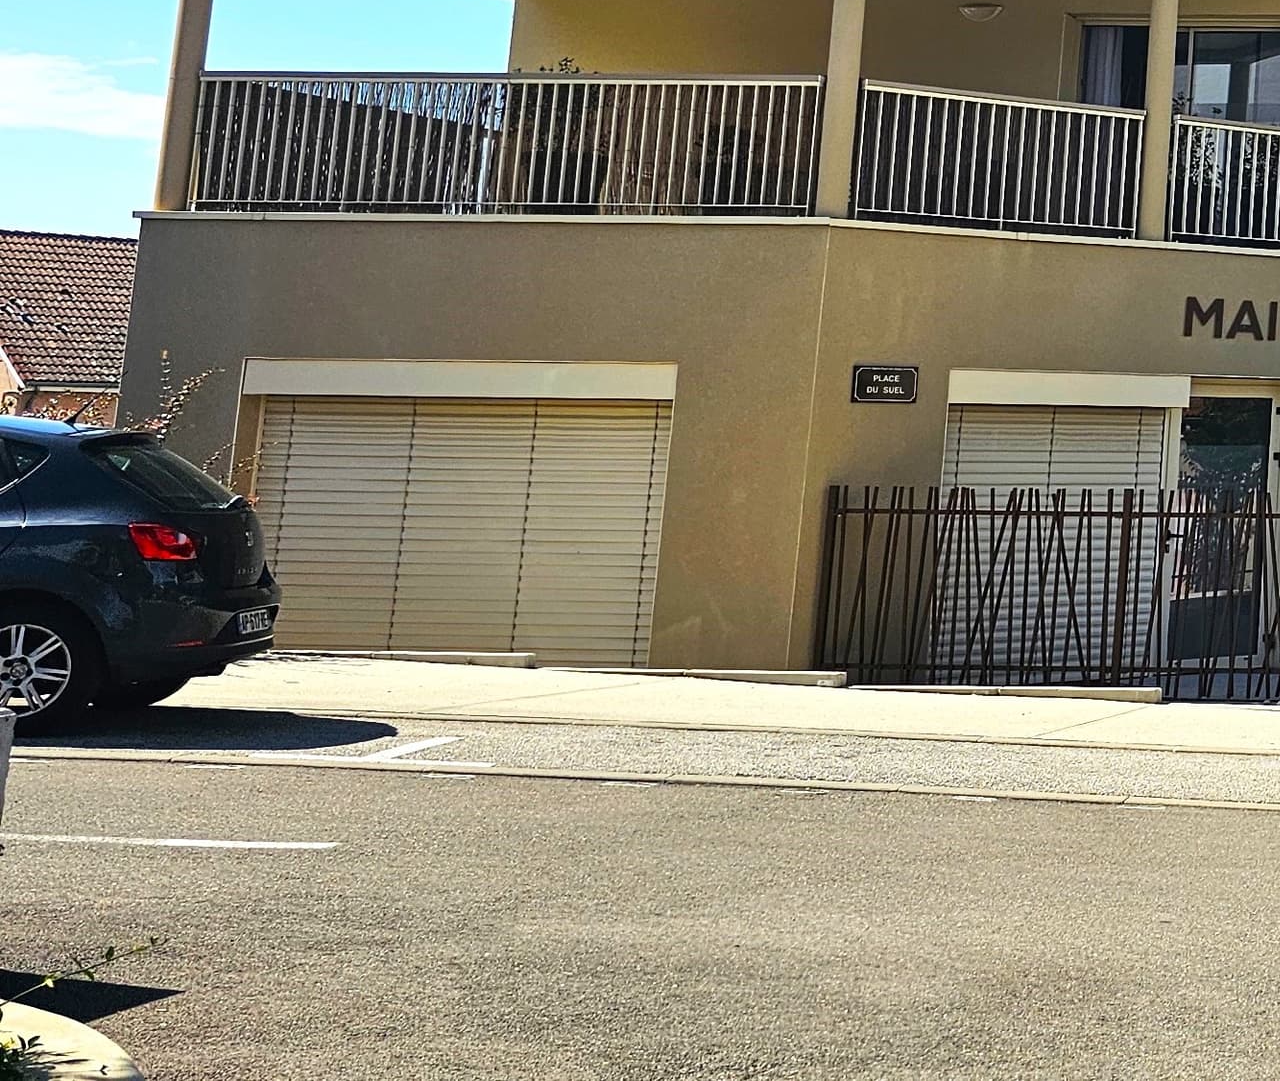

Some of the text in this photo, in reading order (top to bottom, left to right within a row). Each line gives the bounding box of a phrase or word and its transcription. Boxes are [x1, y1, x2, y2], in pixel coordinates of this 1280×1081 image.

[873, 374, 900, 383] PLACE
[866, 386, 905, 394] DU SUEL
